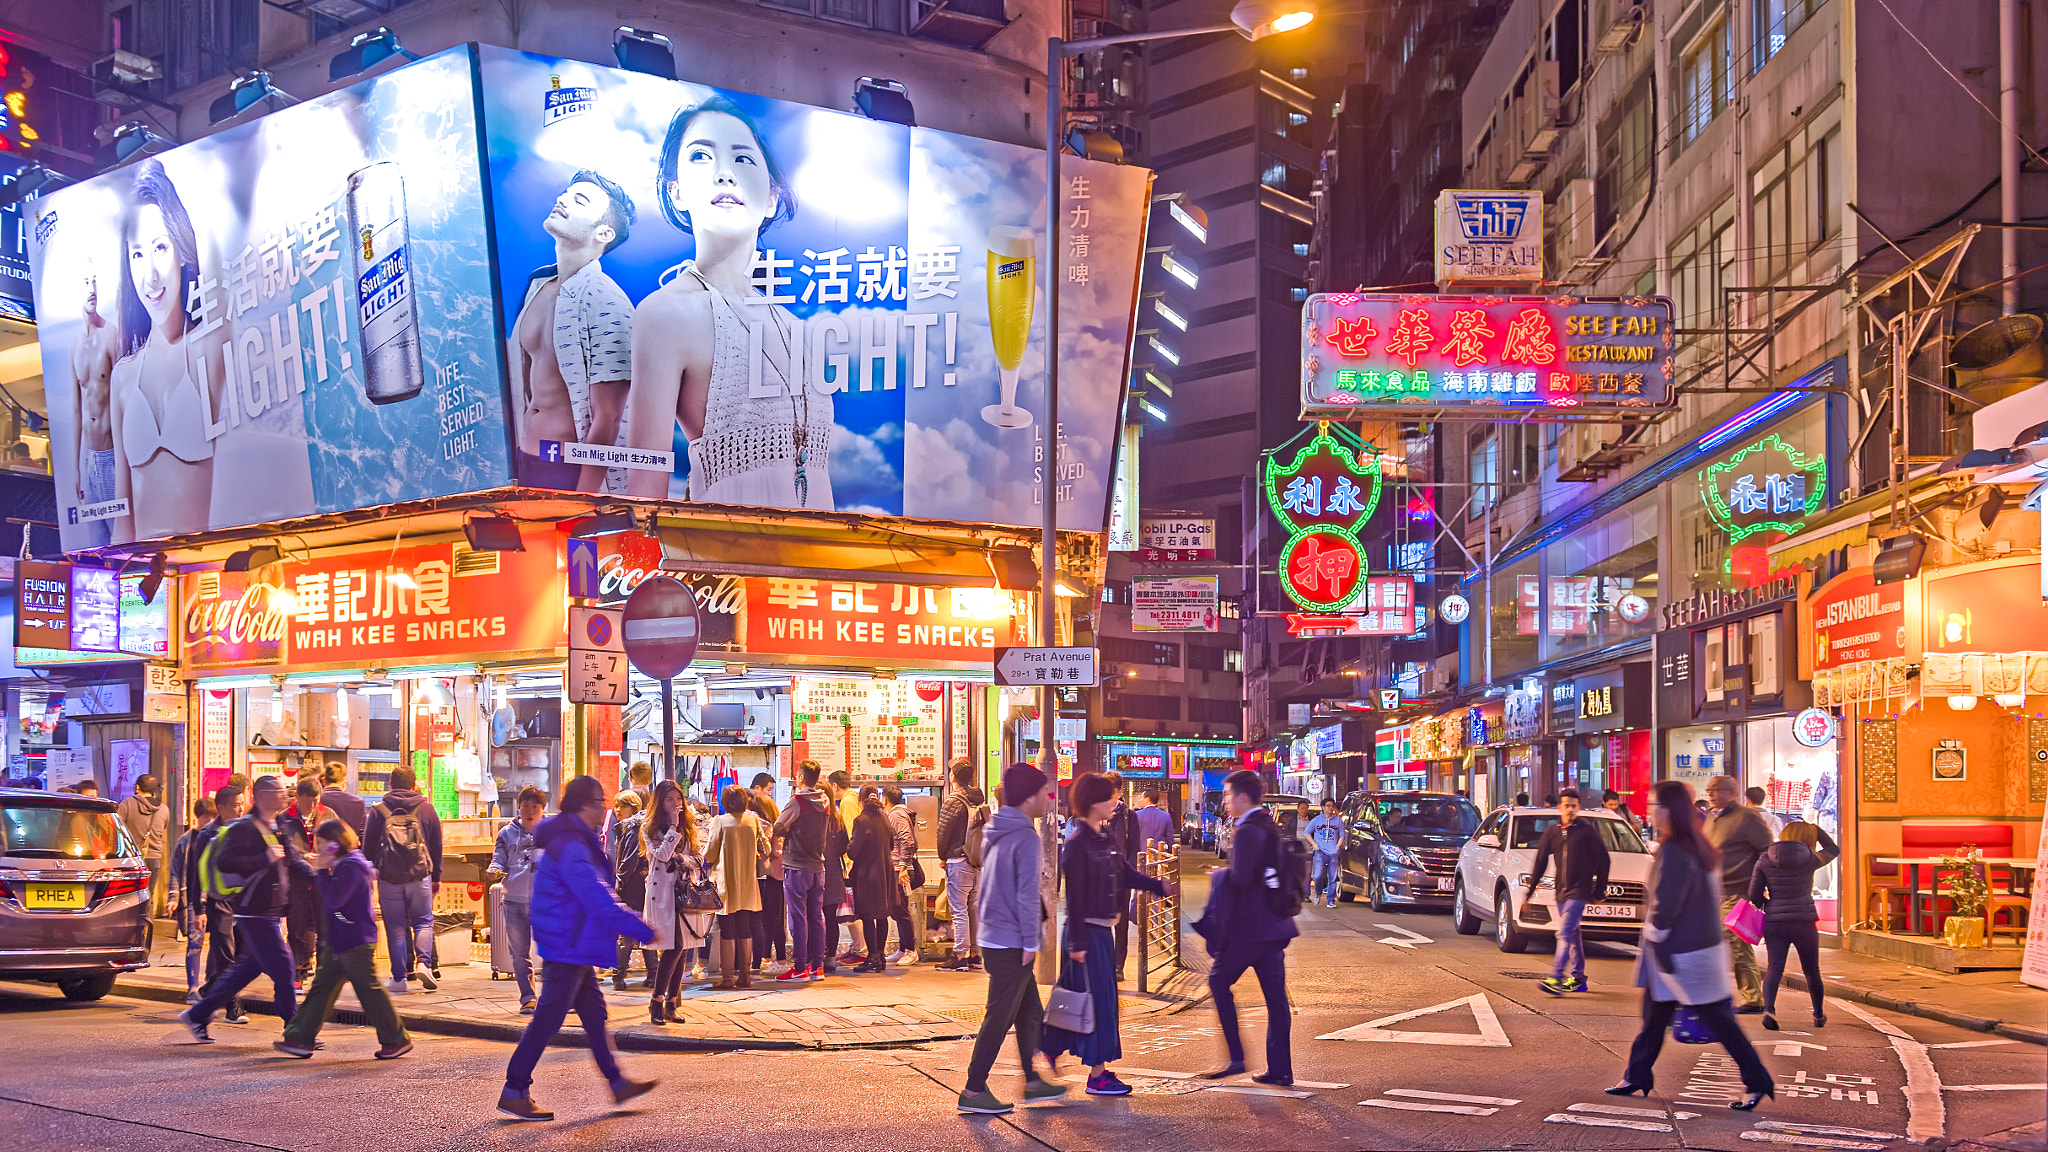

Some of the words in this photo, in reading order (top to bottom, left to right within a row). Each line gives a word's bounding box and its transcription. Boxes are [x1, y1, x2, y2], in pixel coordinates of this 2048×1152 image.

[553, 103, 594, 118] LIGHT
[1068, 175, 1091, 287] 生力清啤
[1444, 246, 1484, 265] SEE
[1490, 246, 1537, 265] FAH
[185, 205, 341, 343] 生活就要
[743, 245, 961, 305] 生活就要
[1565, 316, 1606, 336] SEE
[1611, 316, 1657, 336] FAH
[197, 277, 352, 442] LIGHT!
[748, 312, 958, 399] LIGHT!
[1565, 344, 1656, 363] RESTAURANT
[436, 361, 463, 390] LIFE.
[439, 384, 465, 413] BEST
[441, 401, 484, 437] SERVED
[571, 448, 588, 459] San
[589, 450, 606, 462] Mig
[607, 451, 629, 463] Light
[1140, 523, 1166, 534] obil
[1169, 524, 1211, 534] LP-Gas
[1143, 536, 1202, 547] 美孚石油氣
[1147, 550, 1199, 561] 光明行
[24, 578, 67, 593] FUSION
[295, 560, 450, 625] 華記小食
[23, 591, 66, 606] HAIR
[1182, 611, 1200, 619] 4811
[1827, 592, 1881, 627] ISTANBUL
[48, 619, 66, 630] 1/F
[295, 630, 342, 649] WAH
[352, 624, 396, 645] KEE
[406, 616, 507, 642] SNACKS
[767, 617, 824, 641] WAH
[836, 621, 885, 643] KEE
[897, 624, 996, 648] SNACKS
[1831, 636, 1853, 650] TURKISH
[1852, 634, 1865, 646] FAST
[1864, 632, 1880, 643] FOOD
[1023, 652, 1046, 661] Prat
[1050, 652, 1091, 661] Avenue
[1841, 650, 1855, 660] HONG
[1855, 648, 1870, 659] KONG
[582, 662, 599, 672] 上午
[608, 656, 618, 672] 7
[1011, 669, 1030, 678] 29-1
[1035, 667, 1079, 680] 寶勒巷
[585, 681, 596, 689] pm
[608, 683, 618, 700] 7
[582, 689, 599, 699] 下午
[37, 889, 75, 902] RHEA
[1587, 905, 1601, 915] RC
[1606, 906, 1631, 916] 3143
